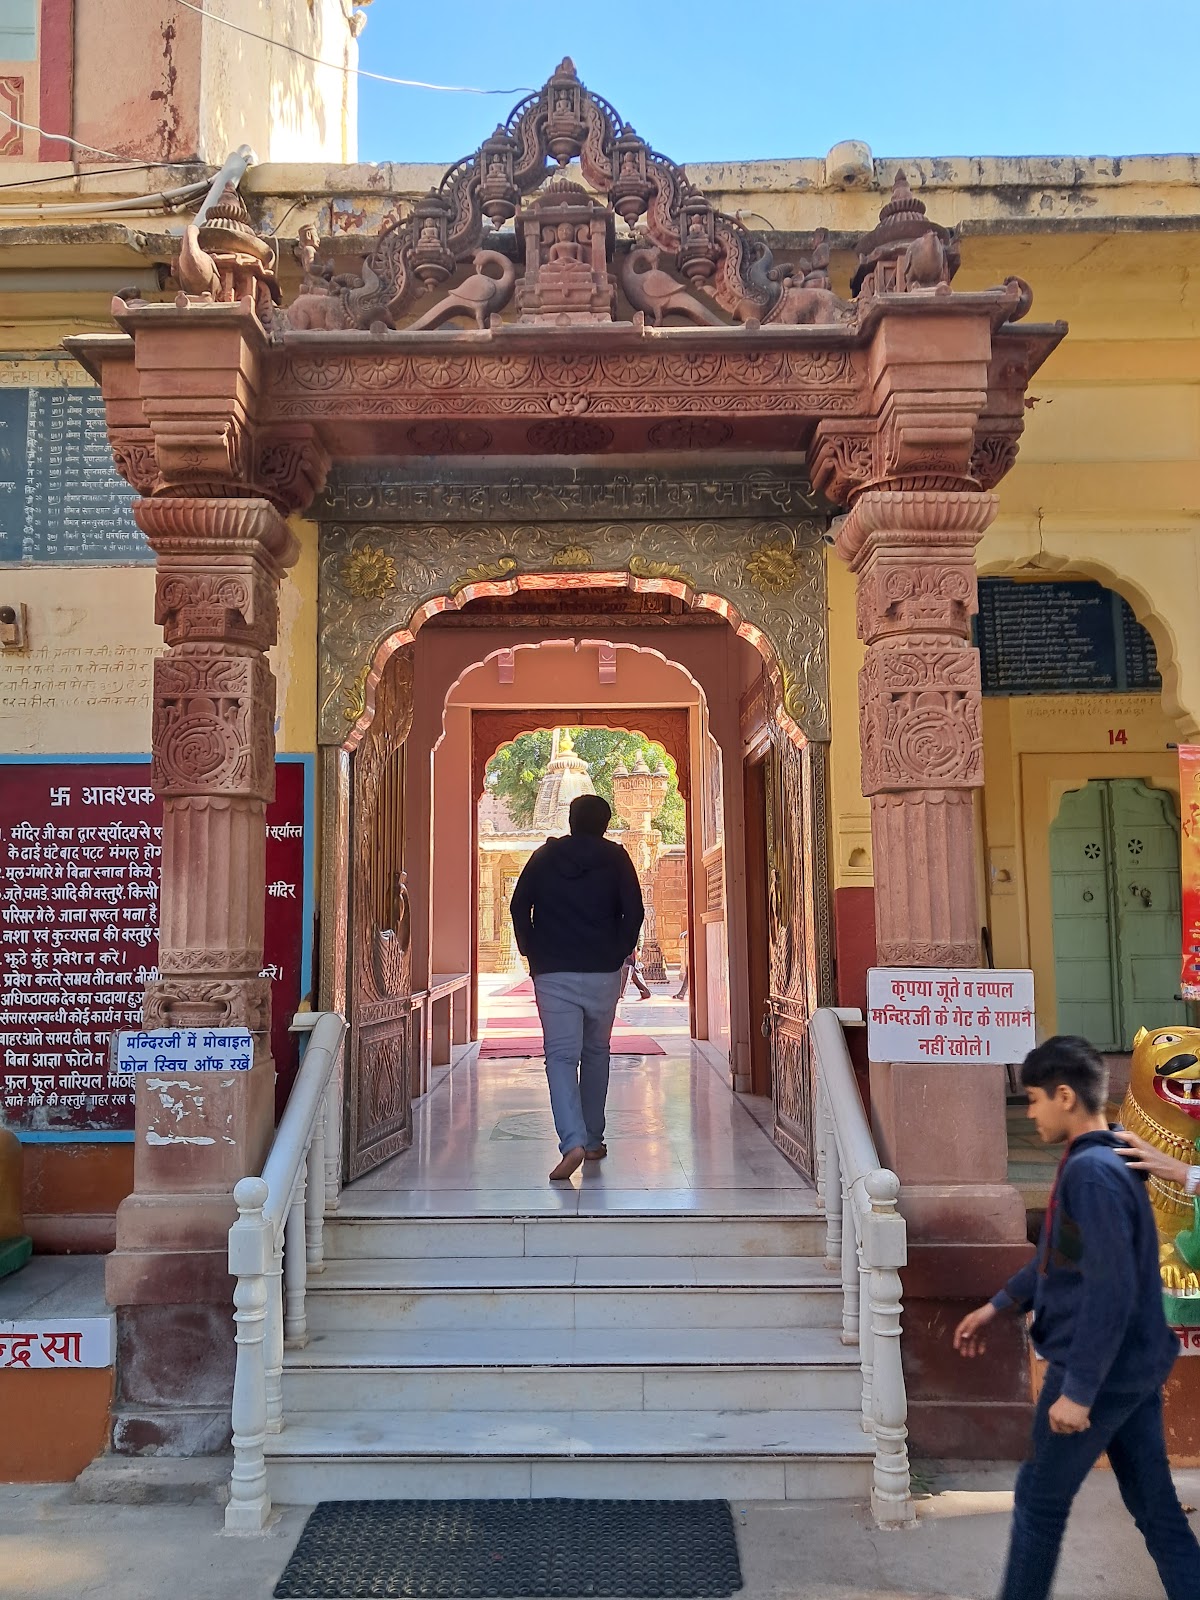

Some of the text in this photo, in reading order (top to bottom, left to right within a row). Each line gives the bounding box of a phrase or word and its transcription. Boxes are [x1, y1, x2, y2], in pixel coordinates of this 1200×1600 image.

[712, 469, 819, 514] मन्दिर
[1108, 729, 1128, 745] 14
[81, 785, 156, 806] आवश्यक
[10, 821, 41, 842] मंदिर
[42, 823, 57, 840] जी
[57, 827, 75, 841] का
[77, 827, 97, 844] द्वार
[97, 821, 140, 844] सूर्योदय
[139, 821, 151, 840] से
[270, 822, 303, 841] सूर्यास्त
[8, 843, 20, 861] के
[21, 842, 41, 862] ढाई
[43, 842, 59, 860] घंटे
[60, 846, 80, 860] बाद
[109, 844, 139, 860] मंगल
[66, 861, 93, 880] बिना
[93, 866, 127, 880] स्नान
[128, 861, 154, 879] किये
[51, 882, 78, 903] आदि
[78, 881, 94, 900] की
[127, 880, 159, 900] किसी
[268, 881, 297, 898] मंदिर
[2, 904, 36, 924] परिसर
[58, 908, 88, 923] जाना
[89, 908, 120, 924] सख्त
[122, 907, 148, 923] मना
[149, 902, 158, 924] है
[3, 929, 29, 944] नशा
[32, 926, 50, 943] एवं
[51, 928, 101, 947] कुव्यसन
[102, 923, 120, 942] की
[30, 947, 49, 968] मुँह
[52, 947, 82, 966] प्रवेश
[84, 951, 96, 965] न
[3, 969, 32, 987] प्रवेश
[35, 968, 63, 986] करते
[62, 972, 92, 986] समय
[92, 967, 115, 986] तीन
[115, 972, 133, 985] बार
[1, 987, 60, 1006] अधिष्ठायक
[60, 987, 77, 1007] देव
[77, 992, 92, 1005] का
[93, 991, 127, 1005] चढाया
[890, 976, 1014, 1003] कृपया जूते व चप्पल
[0, 1008, 29, 1025] संसार
[68, 1006, 91, 1026] कोई
[90, 1007, 113, 1024] कार्य
[871, 1004, 931, 1026] मन्दिरजी
[934, 1005, 949, 1027] के
[952, 1005, 973, 1027] गेट
[976, 1006, 992, 1027] के
[21, 1028, 43, 1046] आते
[45, 1031, 71, 1046] समय
[72, 1028, 91, 1046] तीन
[126, 1031, 251, 1051] मन्दिरजी में मोबाइल
[918, 1034, 948, 1056] नहीं
[4, 1047, 105, 1069] बिना आज्ञा फोटो न
[120, 1053, 251, 1072] फोन स्विच ऑफ रखें
[46, 1091, 59, 1105] की
[111, 1093, 126, 1106] रख
[40, 1332, 83, 1363] सा
